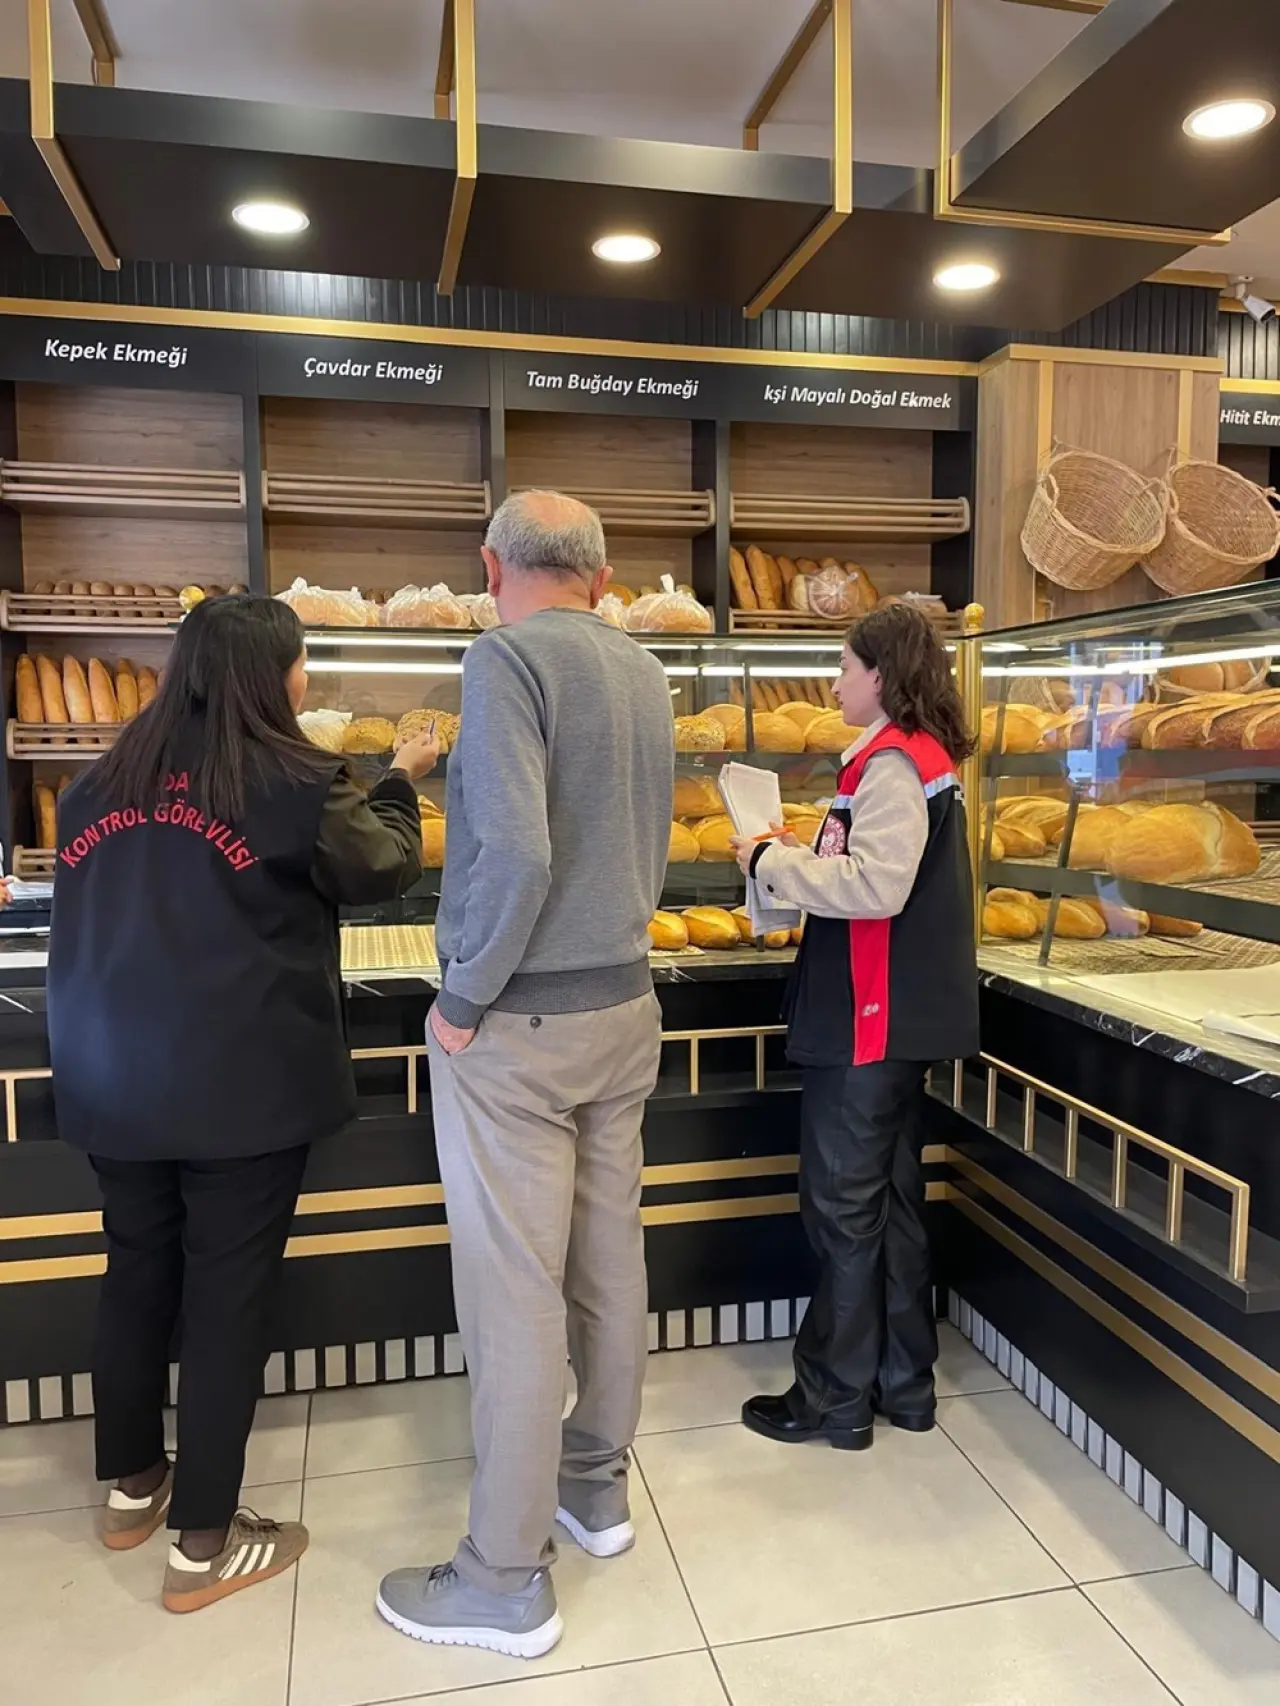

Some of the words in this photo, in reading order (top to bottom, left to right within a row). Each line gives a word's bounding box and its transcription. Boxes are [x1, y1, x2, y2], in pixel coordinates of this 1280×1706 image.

[45, 338, 108, 362] Kepek
[113, 343, 188, 368] Ekmeği
[303, 356, 372, 378] Çavdar
[375, 361, 444, 385] Ekmeği
[526, 370, 563, 389] Tam
[567, 373, 634, 396] Buğday
[636, 377, 699, 400] Ekmeği
[790, 386, 847, 407] Mayalı
[849, 389, 897, 410] Doğal
[899, 391, 953, 409] Ekmek
[1220, 409, 1250, 425] Hitit
[59, 806, 149, 869] KONTROL
[152, 798, 260, 871] GÖREVLİSİ
